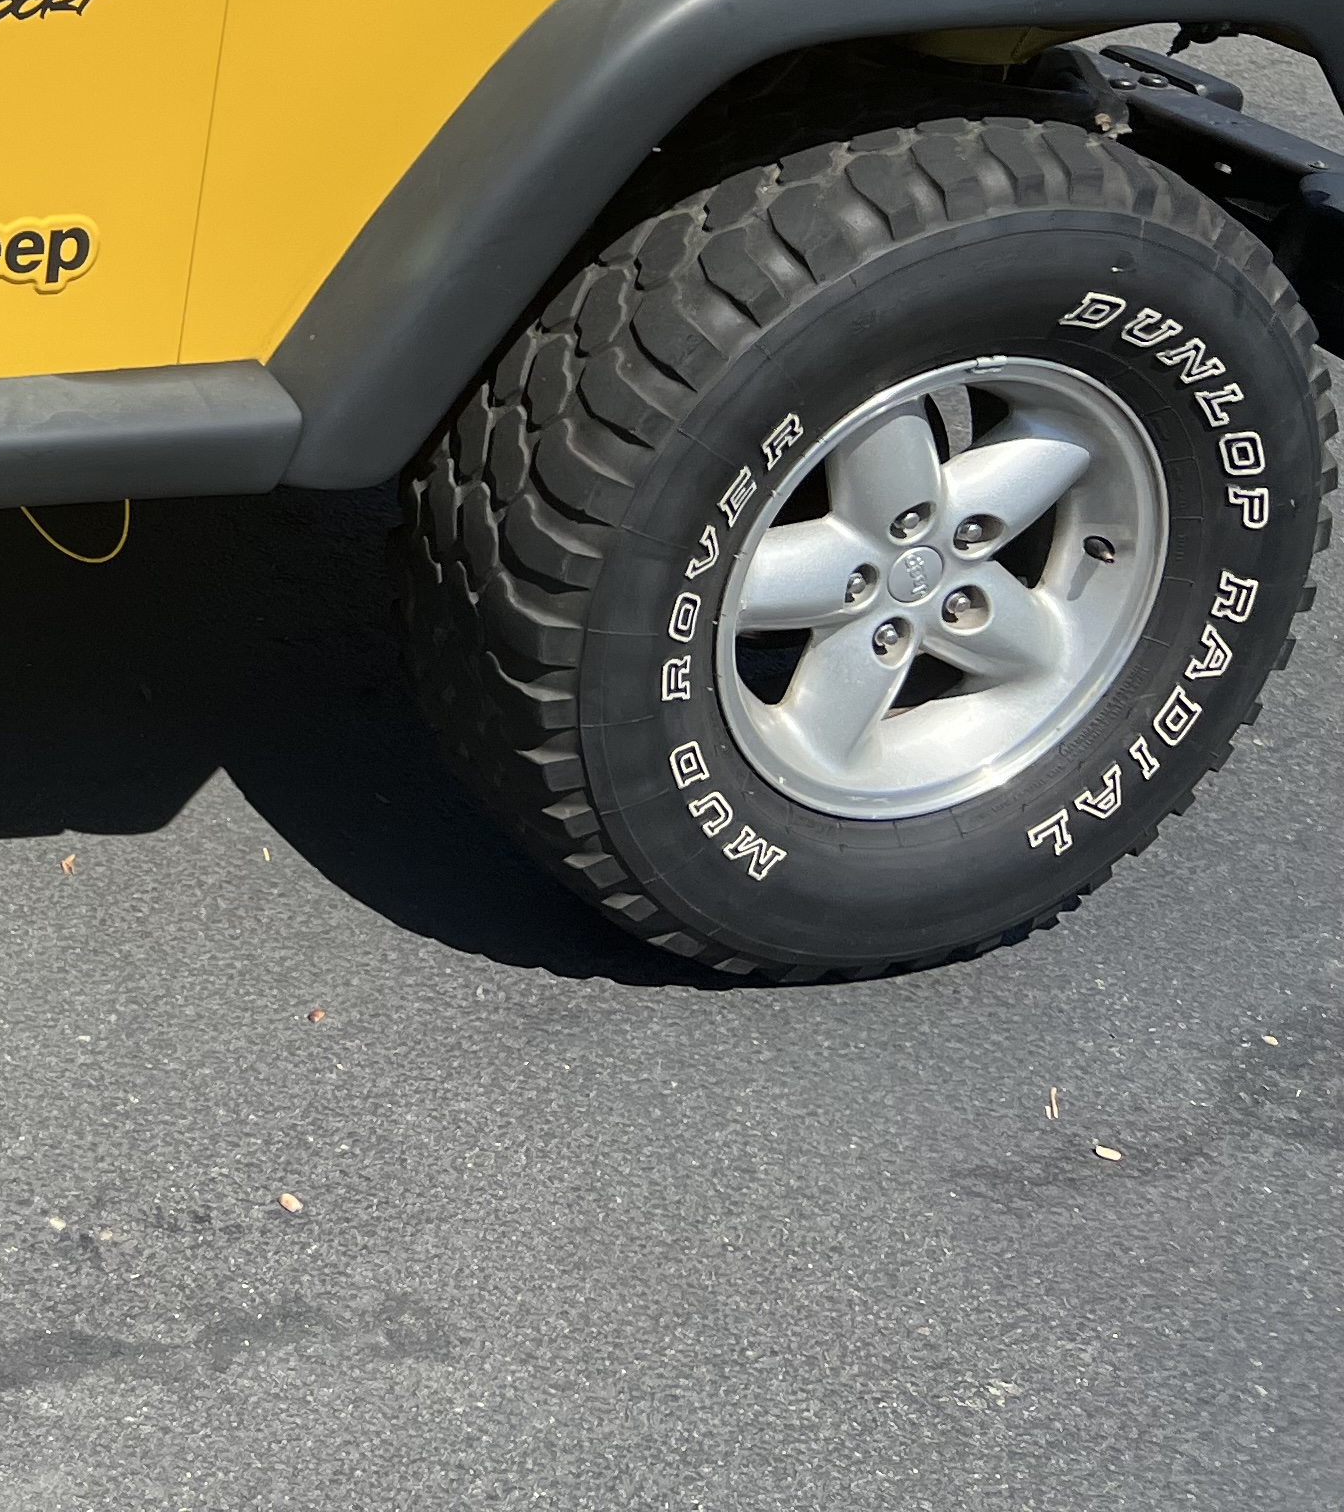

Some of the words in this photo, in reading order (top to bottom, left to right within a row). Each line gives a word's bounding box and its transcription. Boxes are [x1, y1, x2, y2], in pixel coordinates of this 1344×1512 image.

[1059, 290, 1269, 529] DUNLOP
[661, 412, 805, 701] ROVER
[669, 739, 787, 881] MUD
[1027, 569, 1260, 855] RADIAL
